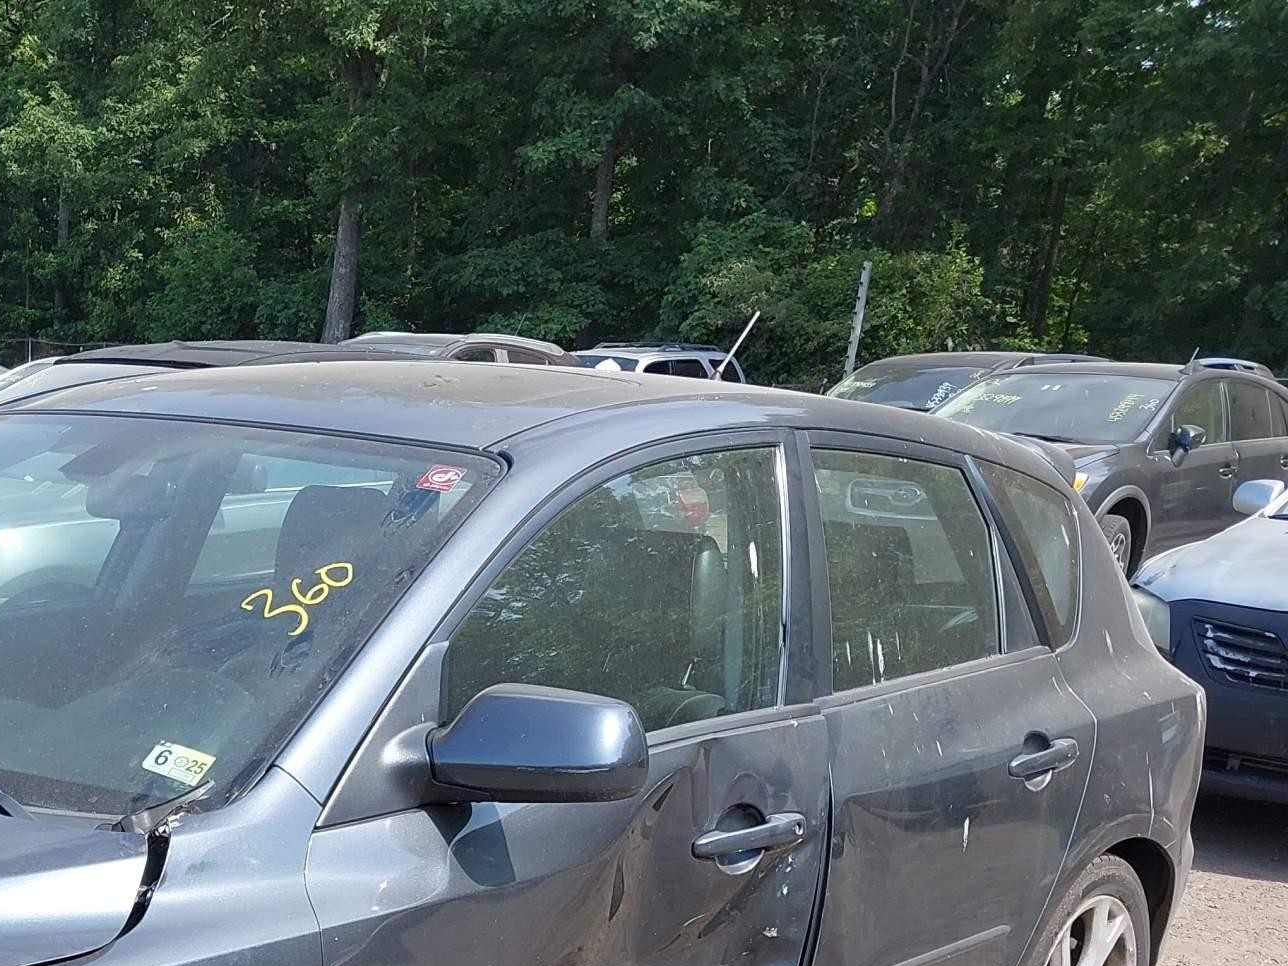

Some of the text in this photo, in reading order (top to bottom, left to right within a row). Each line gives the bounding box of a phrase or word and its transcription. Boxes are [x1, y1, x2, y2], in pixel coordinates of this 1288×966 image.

[240, 562, 353, 636] 360
[154, 749, 208, 775] 6 25
